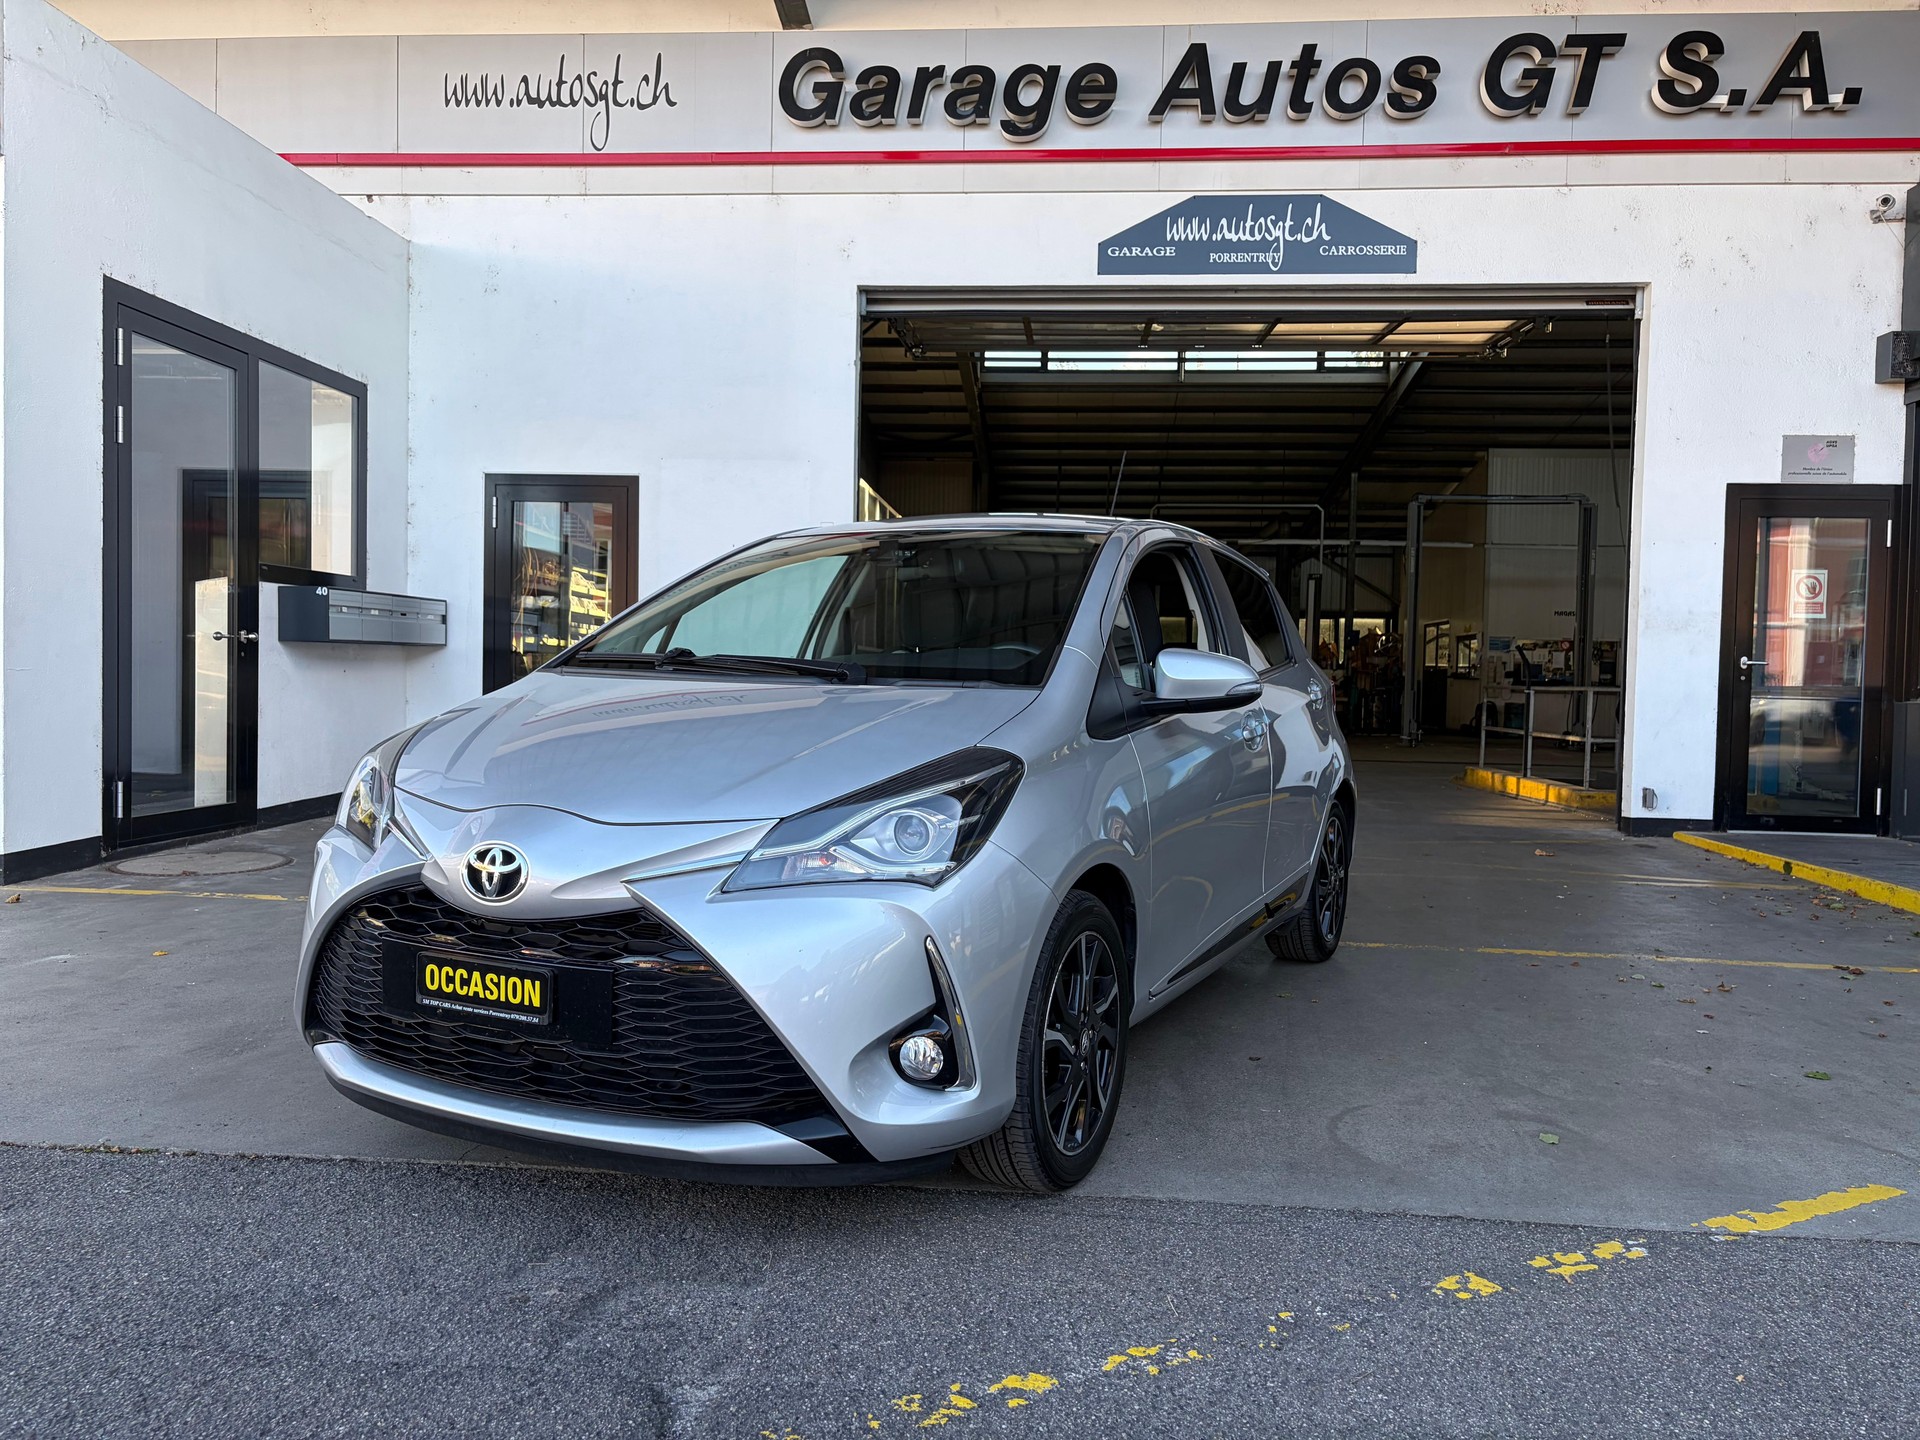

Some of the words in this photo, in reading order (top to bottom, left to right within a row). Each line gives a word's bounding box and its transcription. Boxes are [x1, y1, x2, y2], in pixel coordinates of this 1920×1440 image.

[777, 47, 1118, 144] Garage
[1147, 42, 1442, 123] Autos
[1479, 32, 1628, 117] GT
[1650, 30, 1865, 116] S.A.
[443, 53, 678, 151] www.autosgt.ch
[1166, 202, 1331, 271] www.autosgt.ch
[1319, 245, 1407, 256] CARROSSERIE
[1107, 246, 1176, 257] GARAGE
[1209, 252, 1281, 263] PORRENTRUY
[315, 586, 328, 596] 40
[425, 963, 541, 1008] OCCASION
